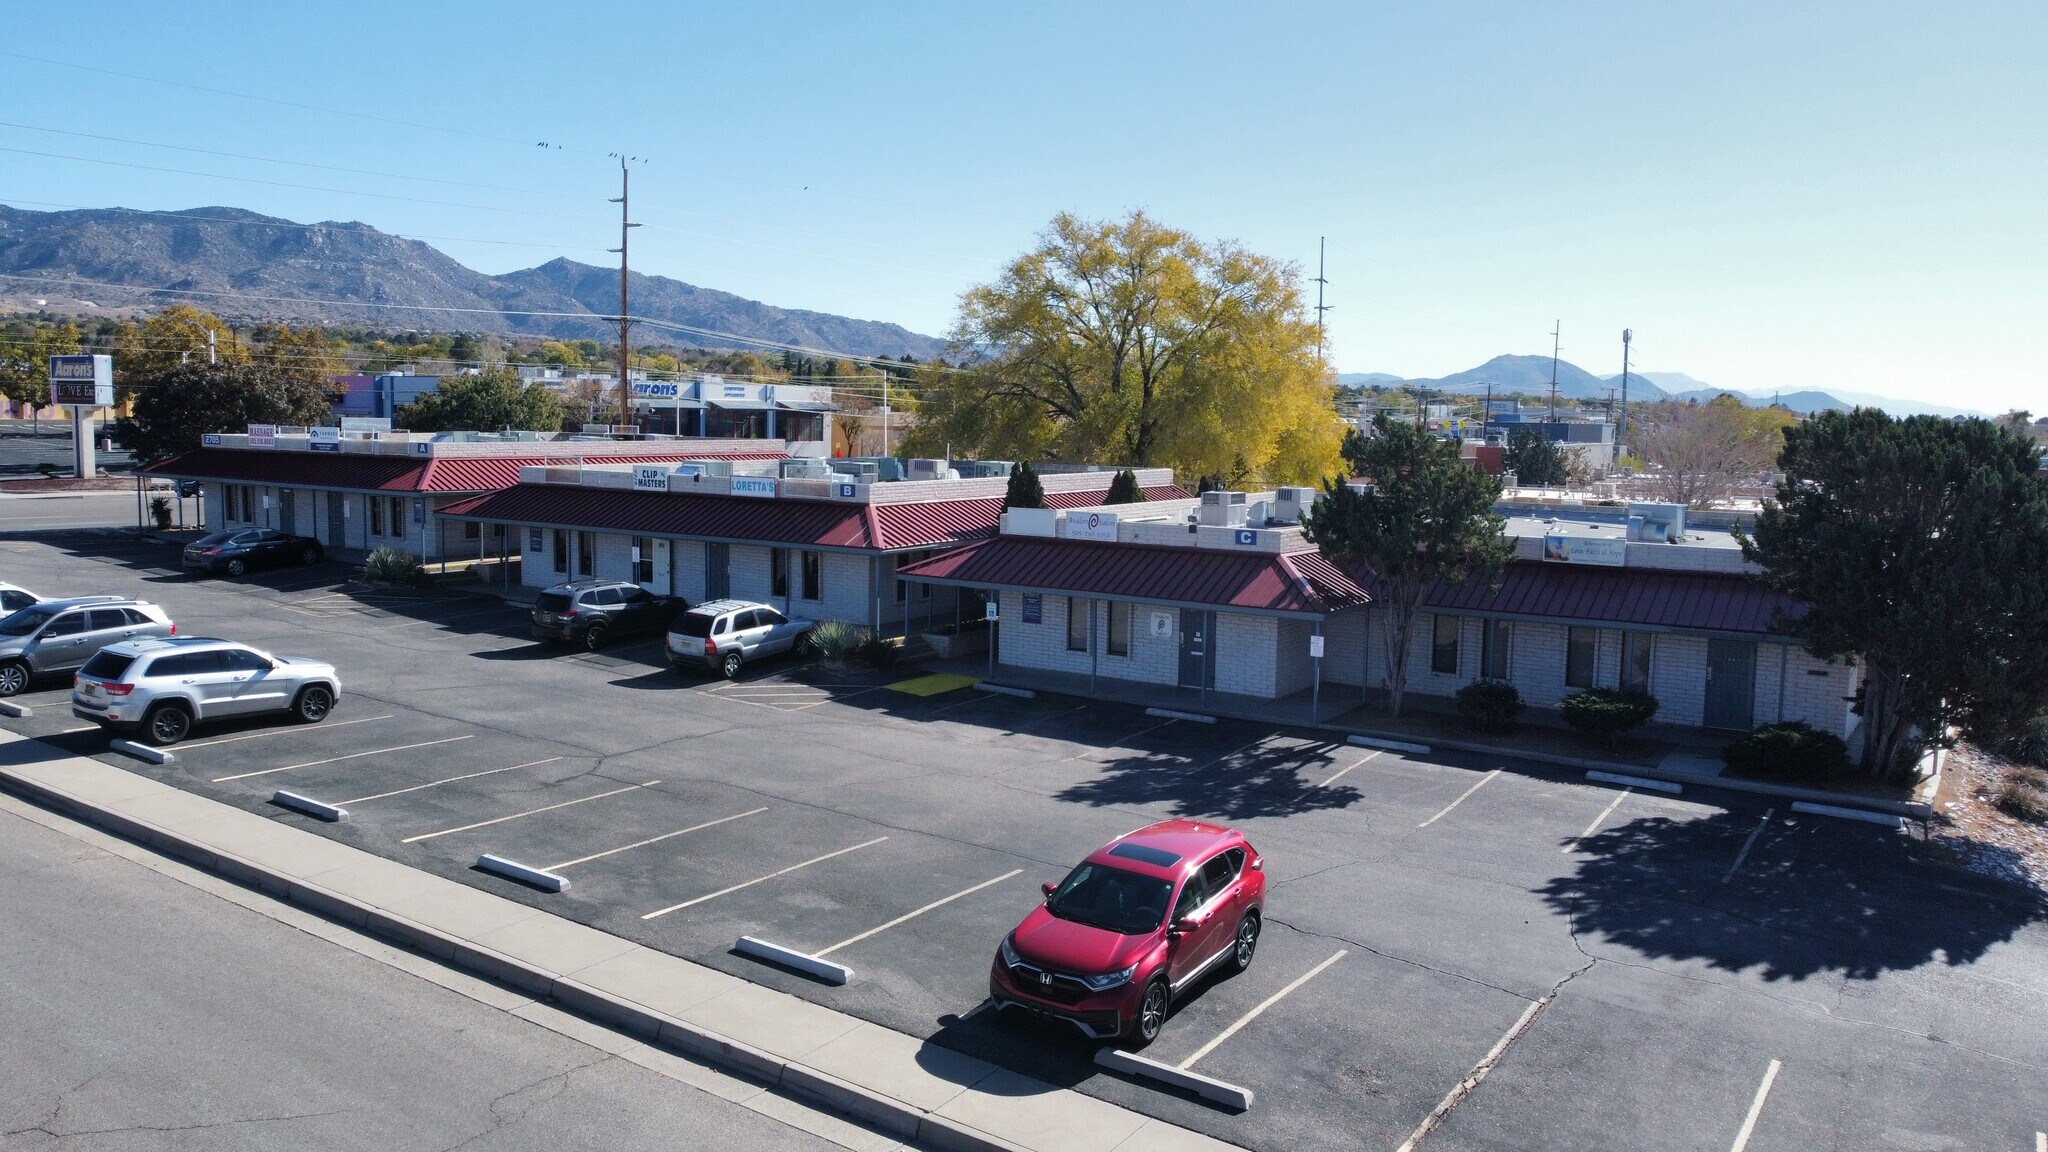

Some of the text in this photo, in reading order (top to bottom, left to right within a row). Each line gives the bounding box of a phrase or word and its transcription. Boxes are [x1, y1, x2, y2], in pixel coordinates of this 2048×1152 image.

[54, 360, 93, 377] Aaron's
[249, 427, 274, 437] MASSAGE
[205, 435, 220, 444] 2705
[419, 443, 426, 452] A
[642, 469, 658, 479] CLIP
[637, 478, 666, 489] MASTERS
[731, 480, 774, 493] LORETTA'S
[843, 485, 851, 496] B
[1068, 516, 1115, 527] Avalon Salon
[1240, 531, 1252, 544] C
